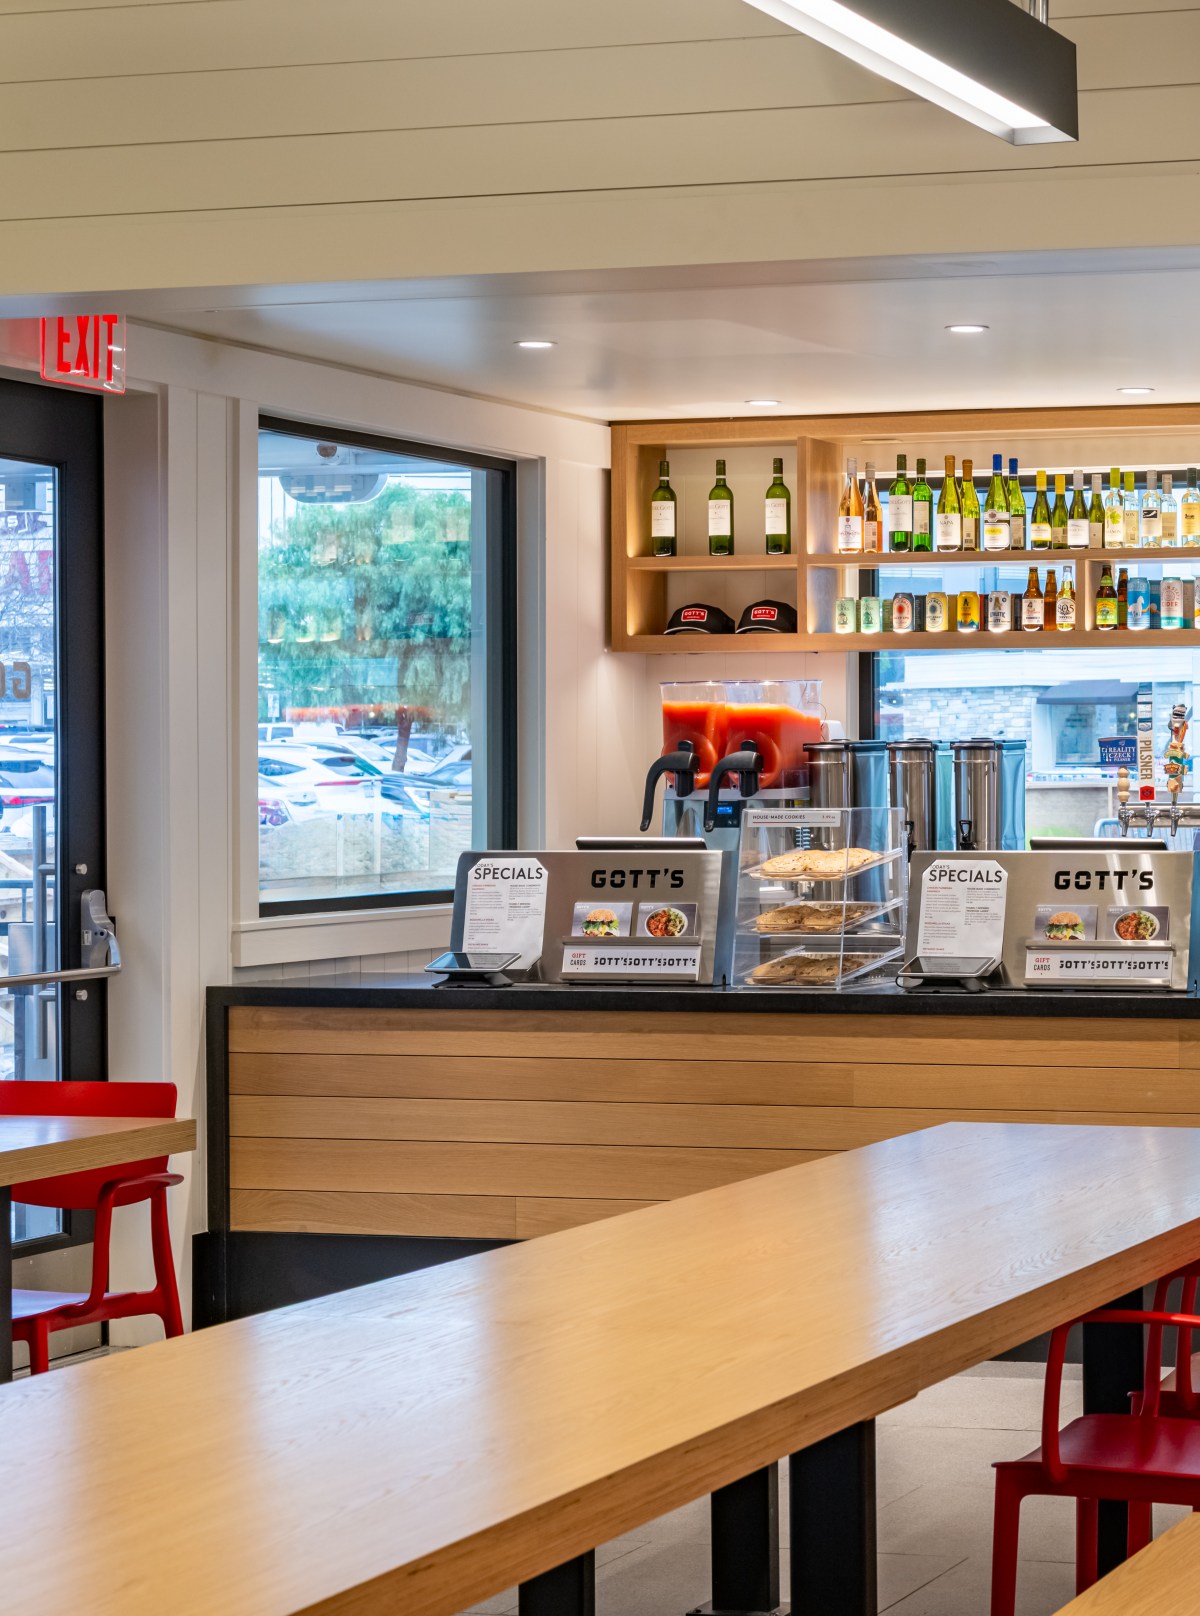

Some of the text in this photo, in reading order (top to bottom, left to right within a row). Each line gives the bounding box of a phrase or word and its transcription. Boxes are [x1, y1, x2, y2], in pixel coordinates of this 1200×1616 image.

[57, 314, 118, 382] EXIT
[1140, 740, 1152, 780] PILSNER
[474, 868, 543, 880] SPECIALS
[591, 868, 684, 888] GOTT'S
[928, 870, 1002, 882] SPECIALS
[1054, 870, 1154, 890] GOTT'S
